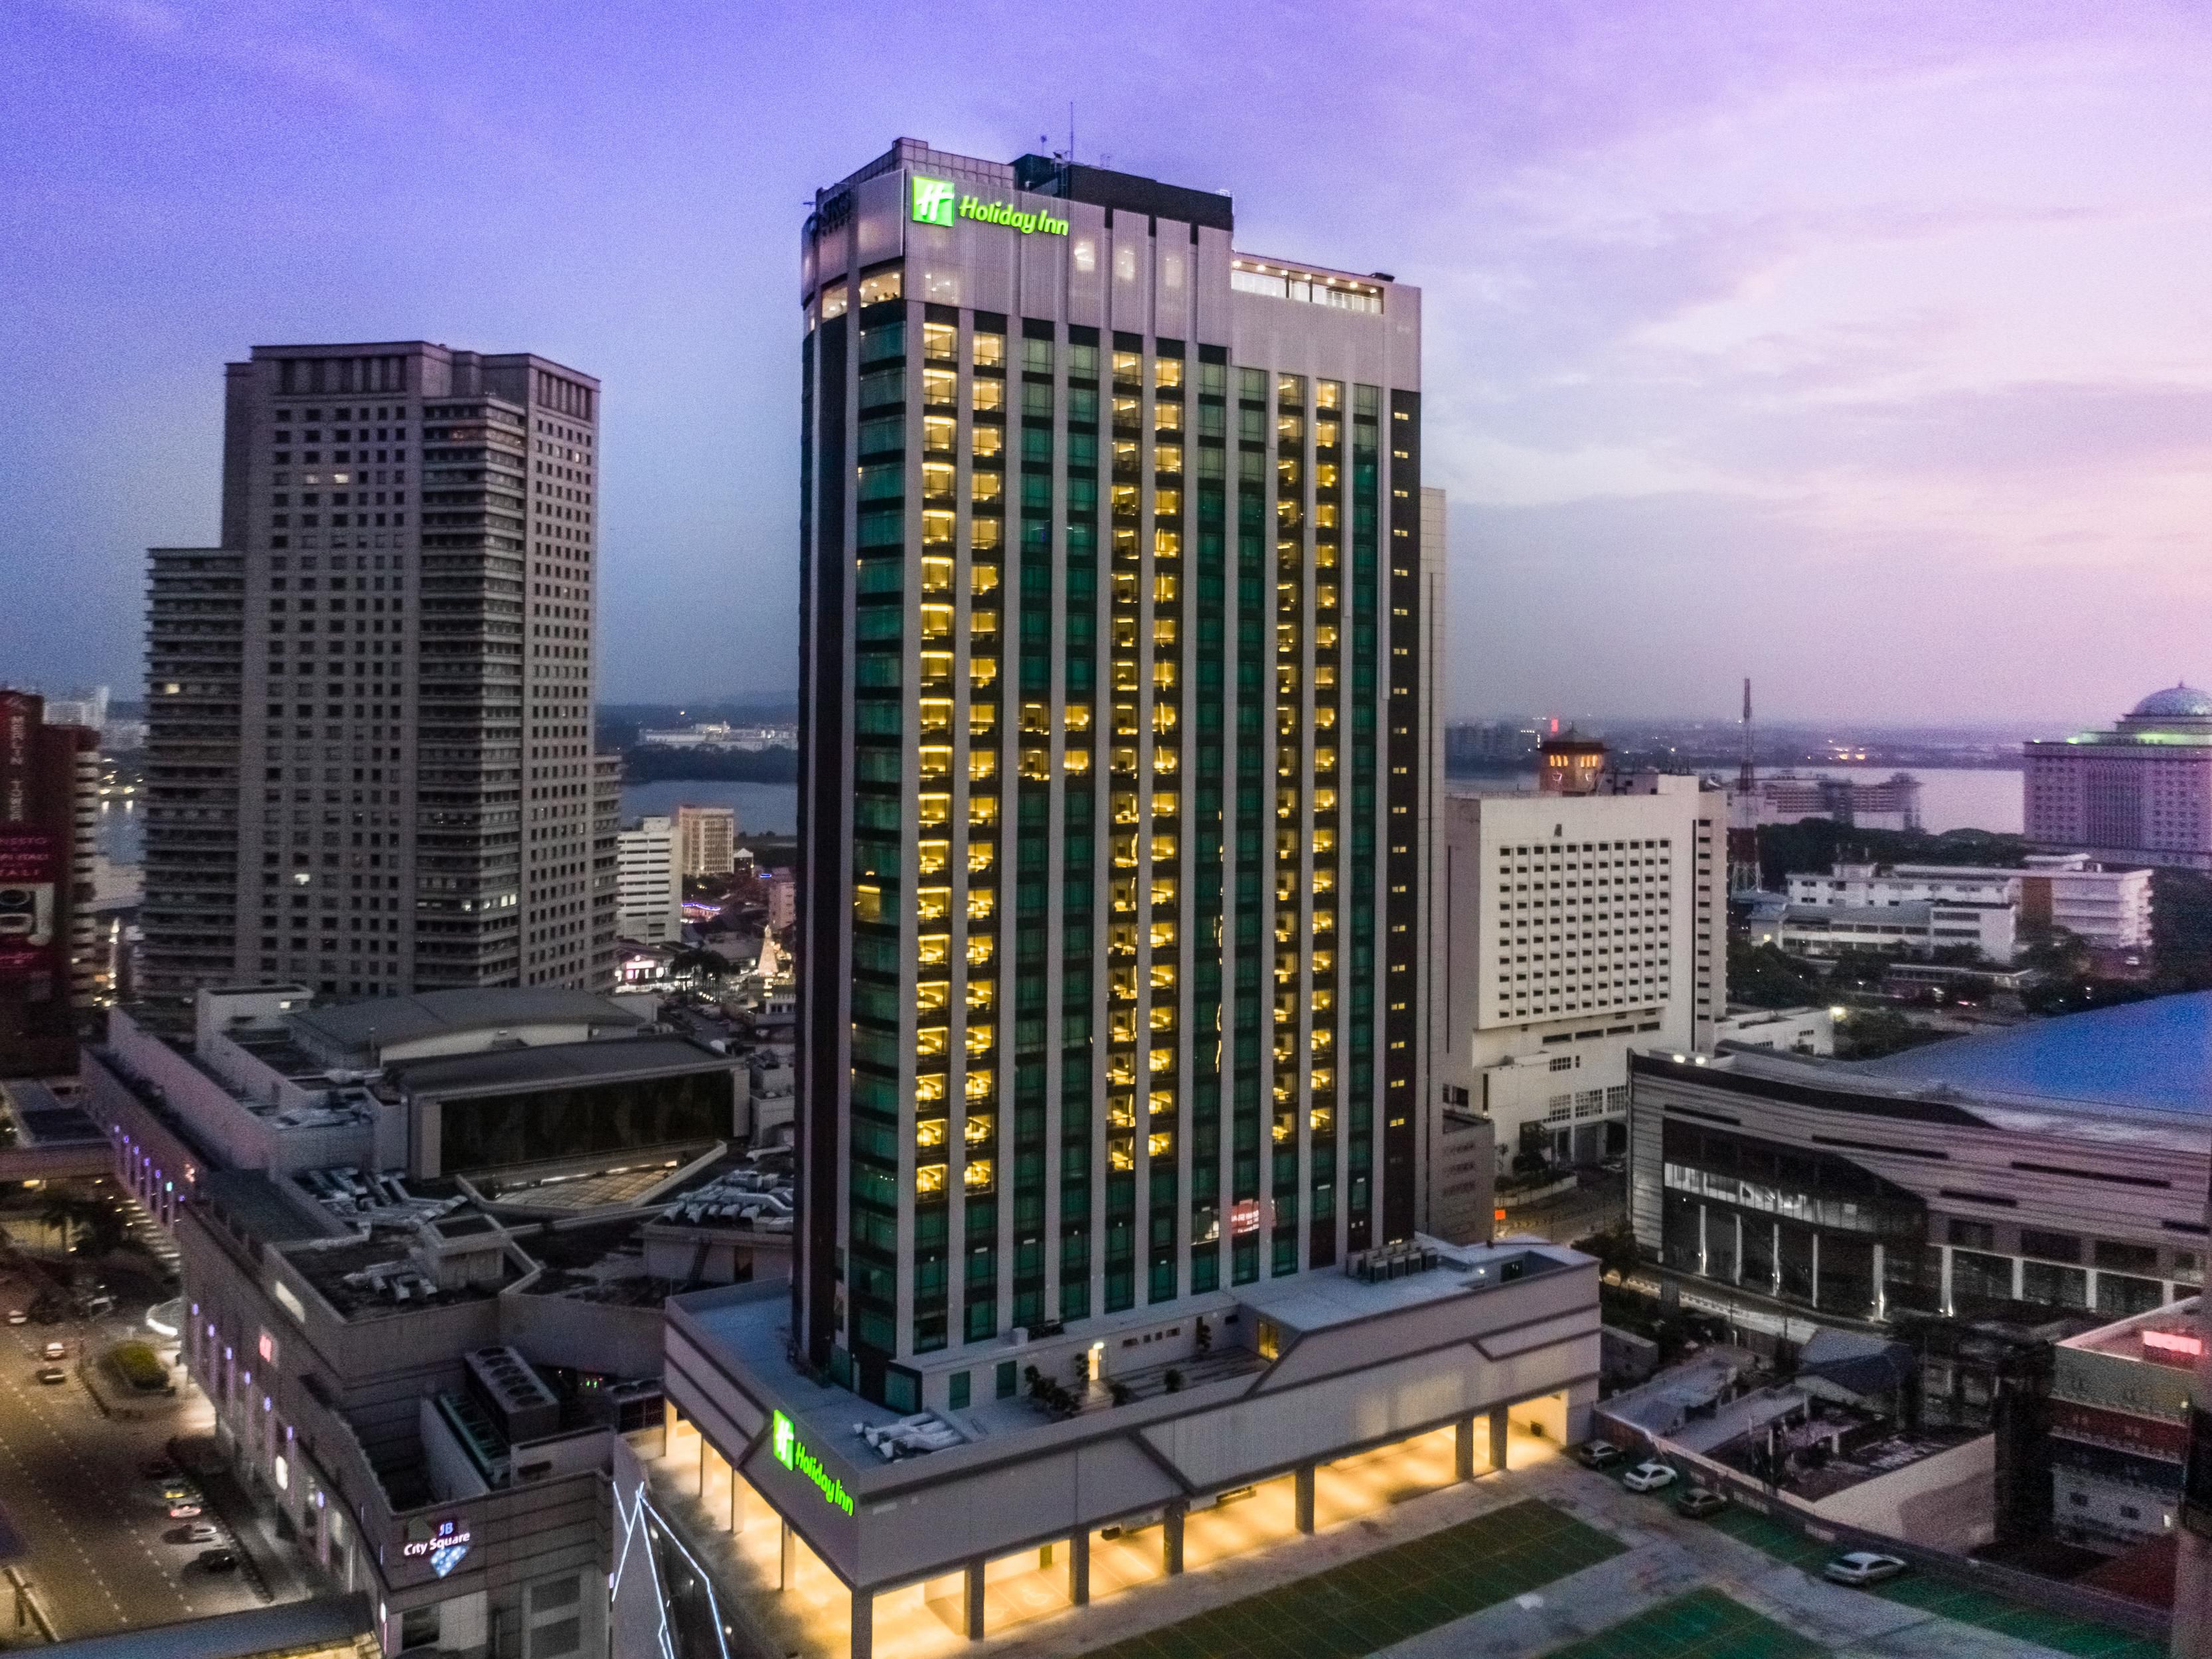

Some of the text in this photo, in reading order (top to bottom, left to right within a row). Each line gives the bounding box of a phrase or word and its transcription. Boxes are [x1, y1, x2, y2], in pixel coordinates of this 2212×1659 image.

[959, 195, 1036, 234] Holiday
[1038, 209, 1069, 236] Inn
[795, 1441, 835, 1503] Holiday
[834, 1479, 854, 1516] Inn
[404, 1532, 471, 1556] City Square
[439, 1522, 453, 1536] JB
